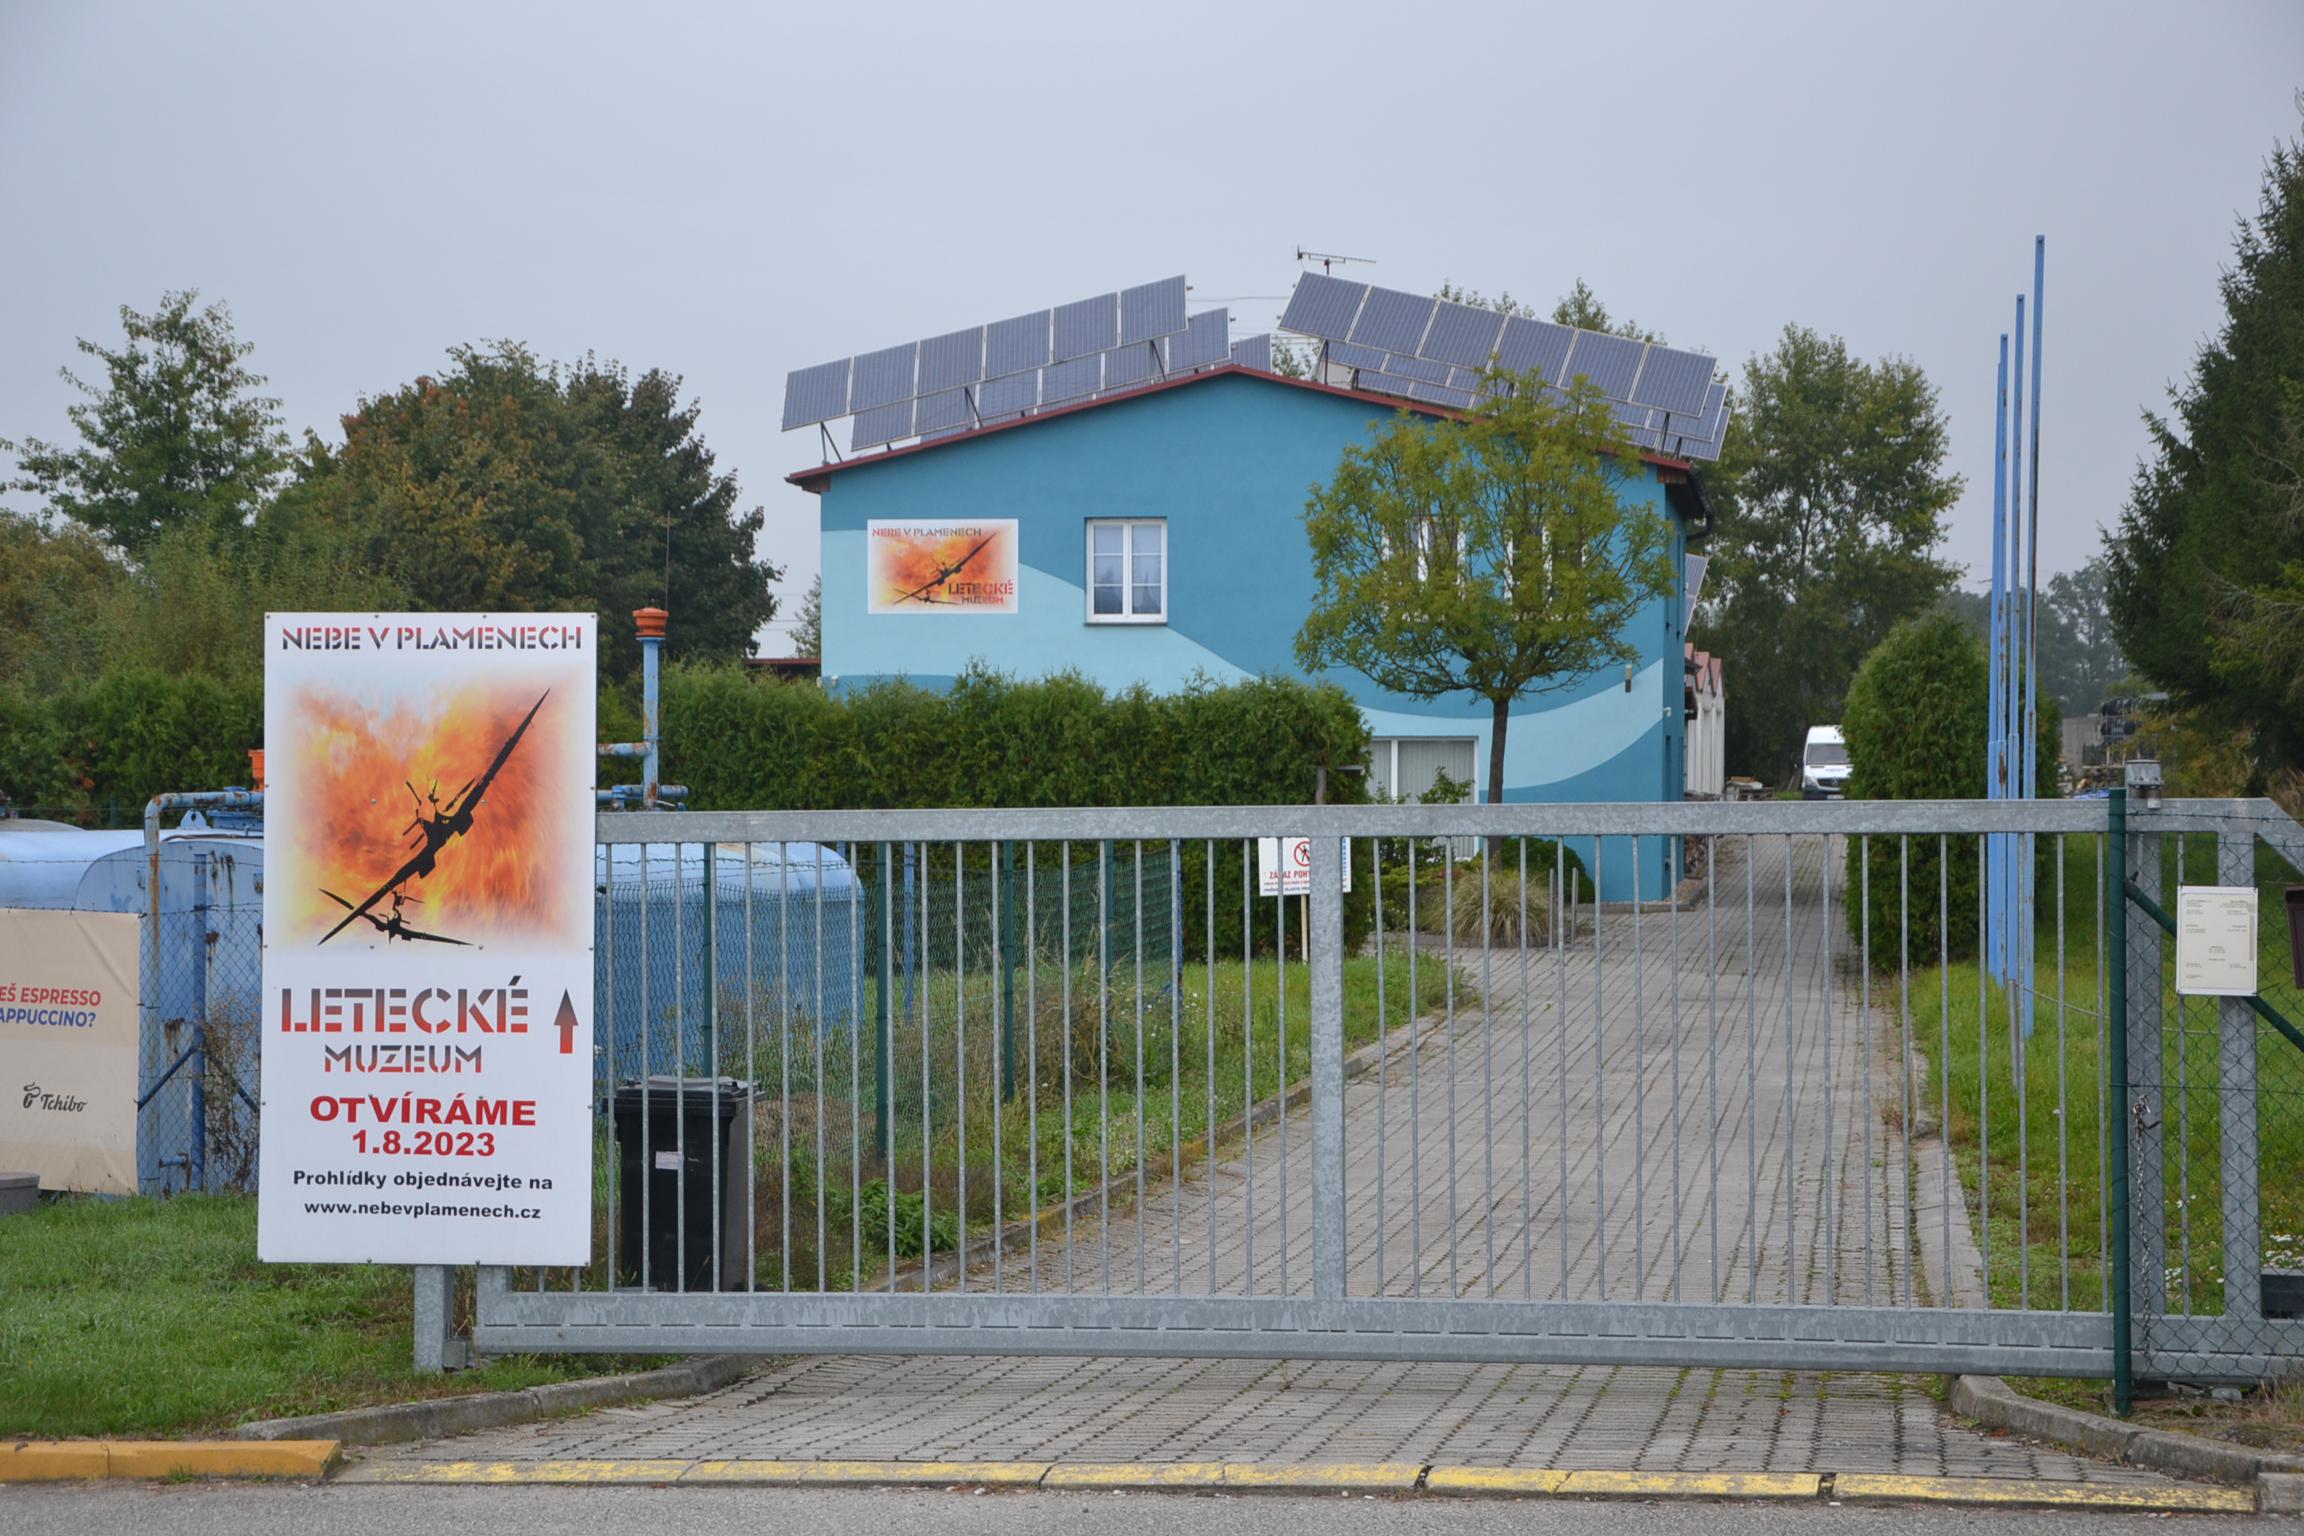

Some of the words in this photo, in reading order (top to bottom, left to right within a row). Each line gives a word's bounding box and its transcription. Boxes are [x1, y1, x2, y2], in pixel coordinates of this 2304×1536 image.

[872, 528, 901, 537] NEBE
[903, 528, 911, 537] V
[913, 528, 982, 537] PLAMENECH
[948, 580, 1014, 595] LETECKÉ
[961, 595, 1004, 605] MUZEUM
[282, 627, 361, 650] NEBE
[368, 627, 390, 650] V
[397, 626, 582, 650] PLAMENECH
[1269, 870, 1291, 879] ZÁAZ
[20, 987, 101, 1006] ESPRESSO
[281, 975, 528, 1033] LETECKÉ
[0, 1007, 96, 1028] APPUCCINO?
[324, 1044, 482, 1073] MUZEUM
[40, 1094, 88, 1112] Tchibo
[310, 1091, 536, 1126] OTVÍRÁME
[352, 1130, 496, 1156] 1.8.2023
[294, 1170, 387, 1189] Prohlídky
[393, 1172, 522, 1191] objednávejte
[529, 1177, 553, 1190] na
[304, 1201, 541, 1220] www.nebevplamenech.cz
